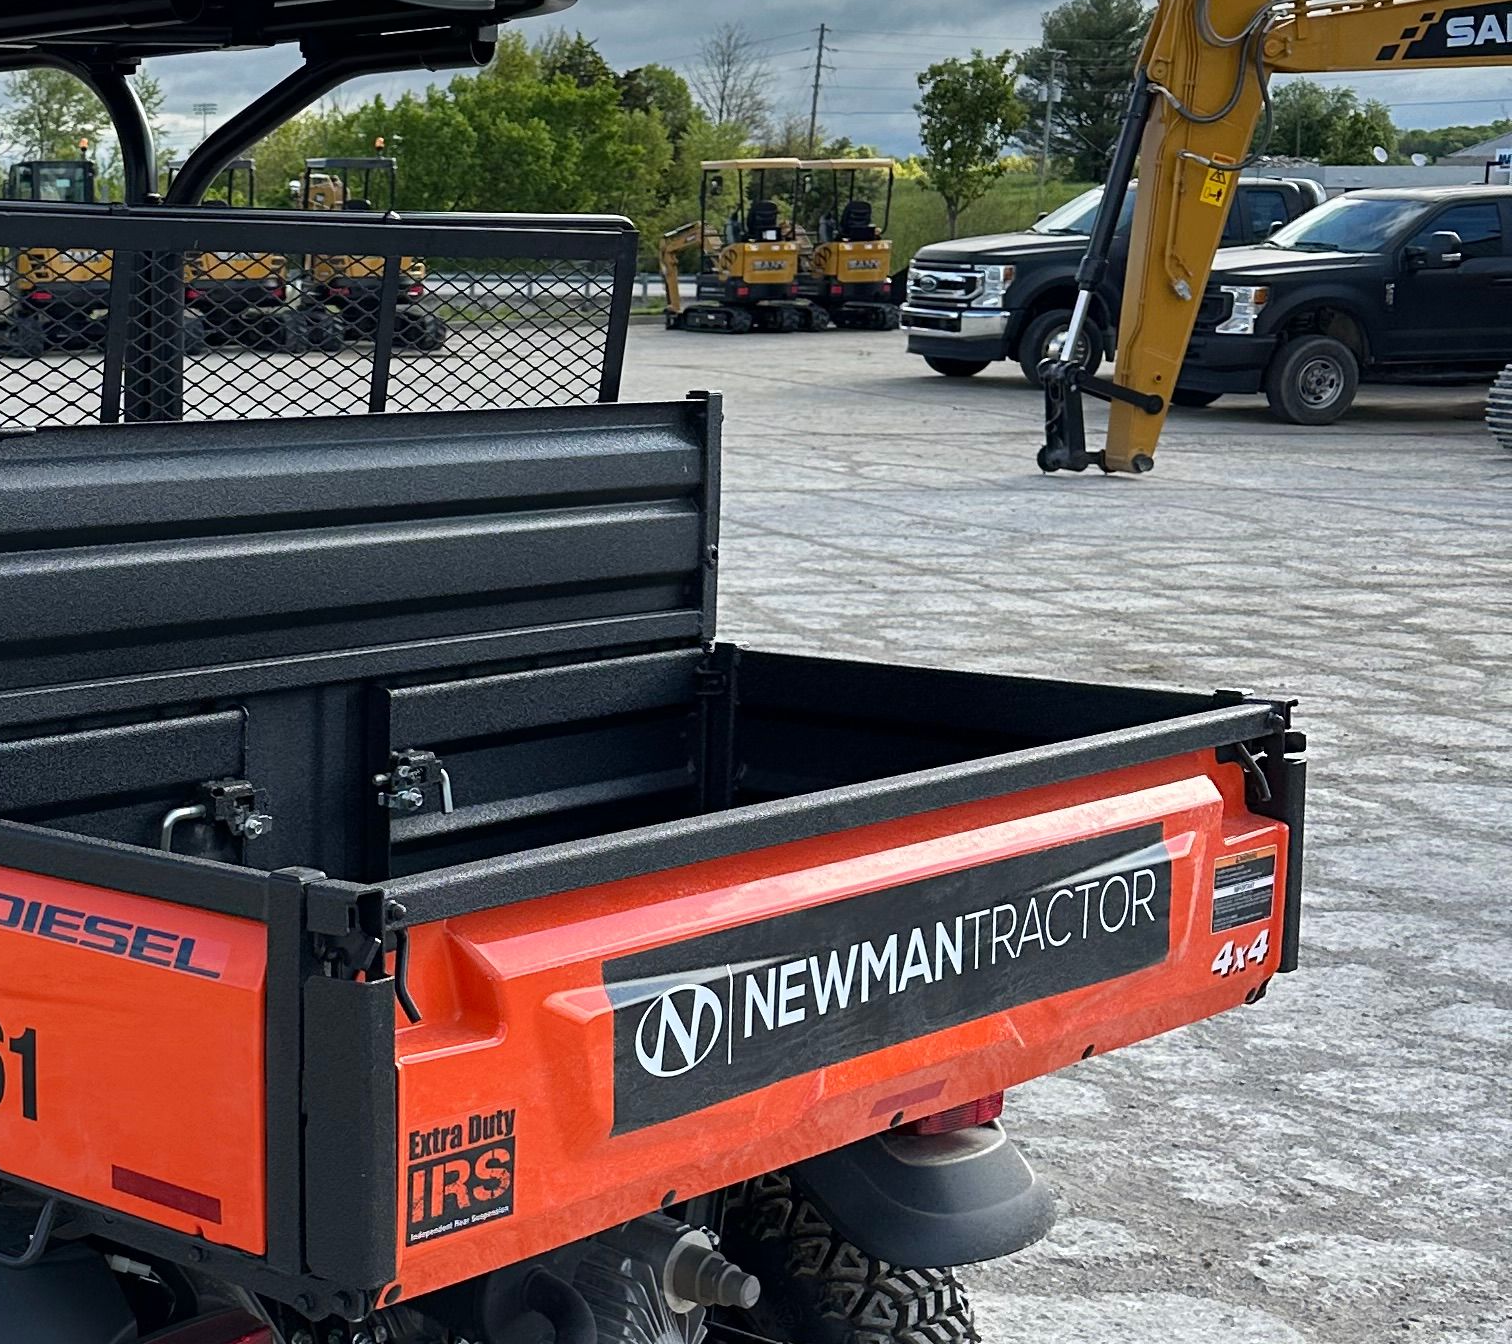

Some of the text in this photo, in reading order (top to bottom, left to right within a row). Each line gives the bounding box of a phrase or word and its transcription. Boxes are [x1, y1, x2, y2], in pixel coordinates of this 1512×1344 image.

[1446, 14, 1512, 47] SA
[1211, 928, 1270, 978] 4x4
[409, 1108, 516, 1162] Extra Duty
[411, 1147, 511, 1224] IRS
